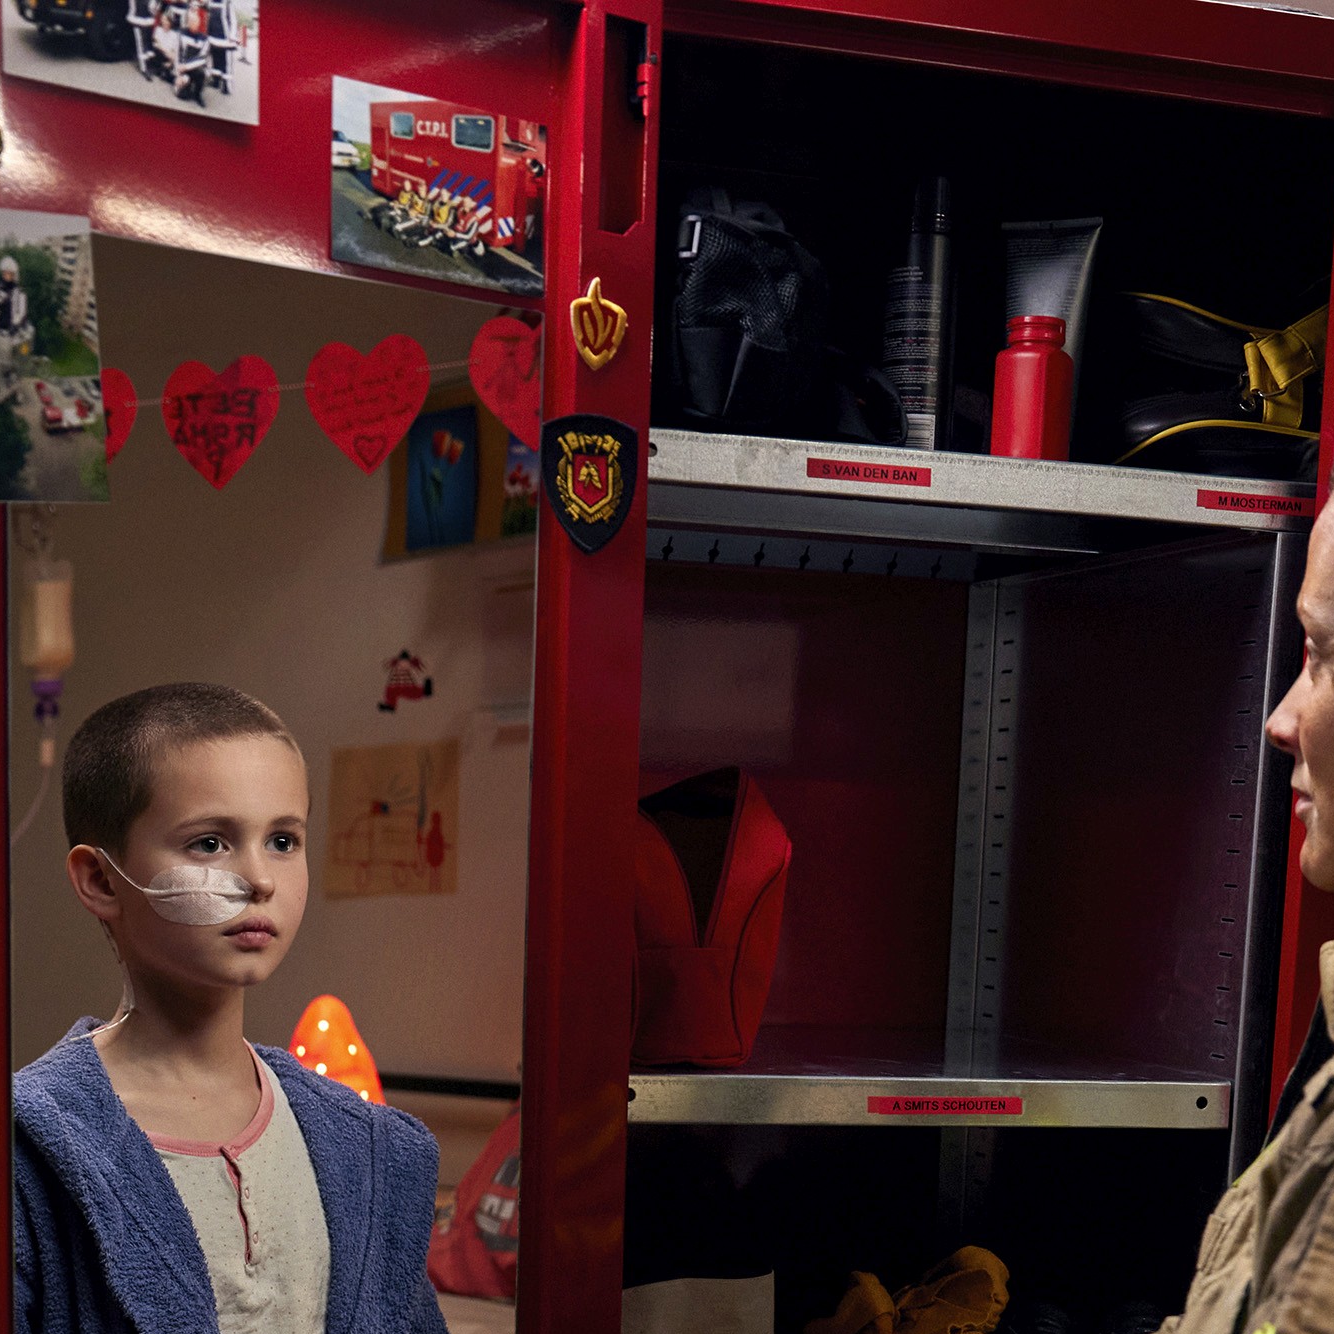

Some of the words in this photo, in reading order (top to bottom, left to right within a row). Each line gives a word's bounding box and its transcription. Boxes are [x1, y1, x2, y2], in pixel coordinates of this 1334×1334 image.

[822, 464, 831, 475] S
[834, 465, 860, 477] VAN
[864, 467, 888, 479] DEN
[892, 469, 918, 481] BAN
[1218, 495, 1228, 506] M
[1230, 496, 1303, 512] MOSTERMAN
[892, 1101, 902, 1111] A
[904, 1100, 940, 1111] SMITS
[942, 1100, 1006, 1111] SCHOUTEN
